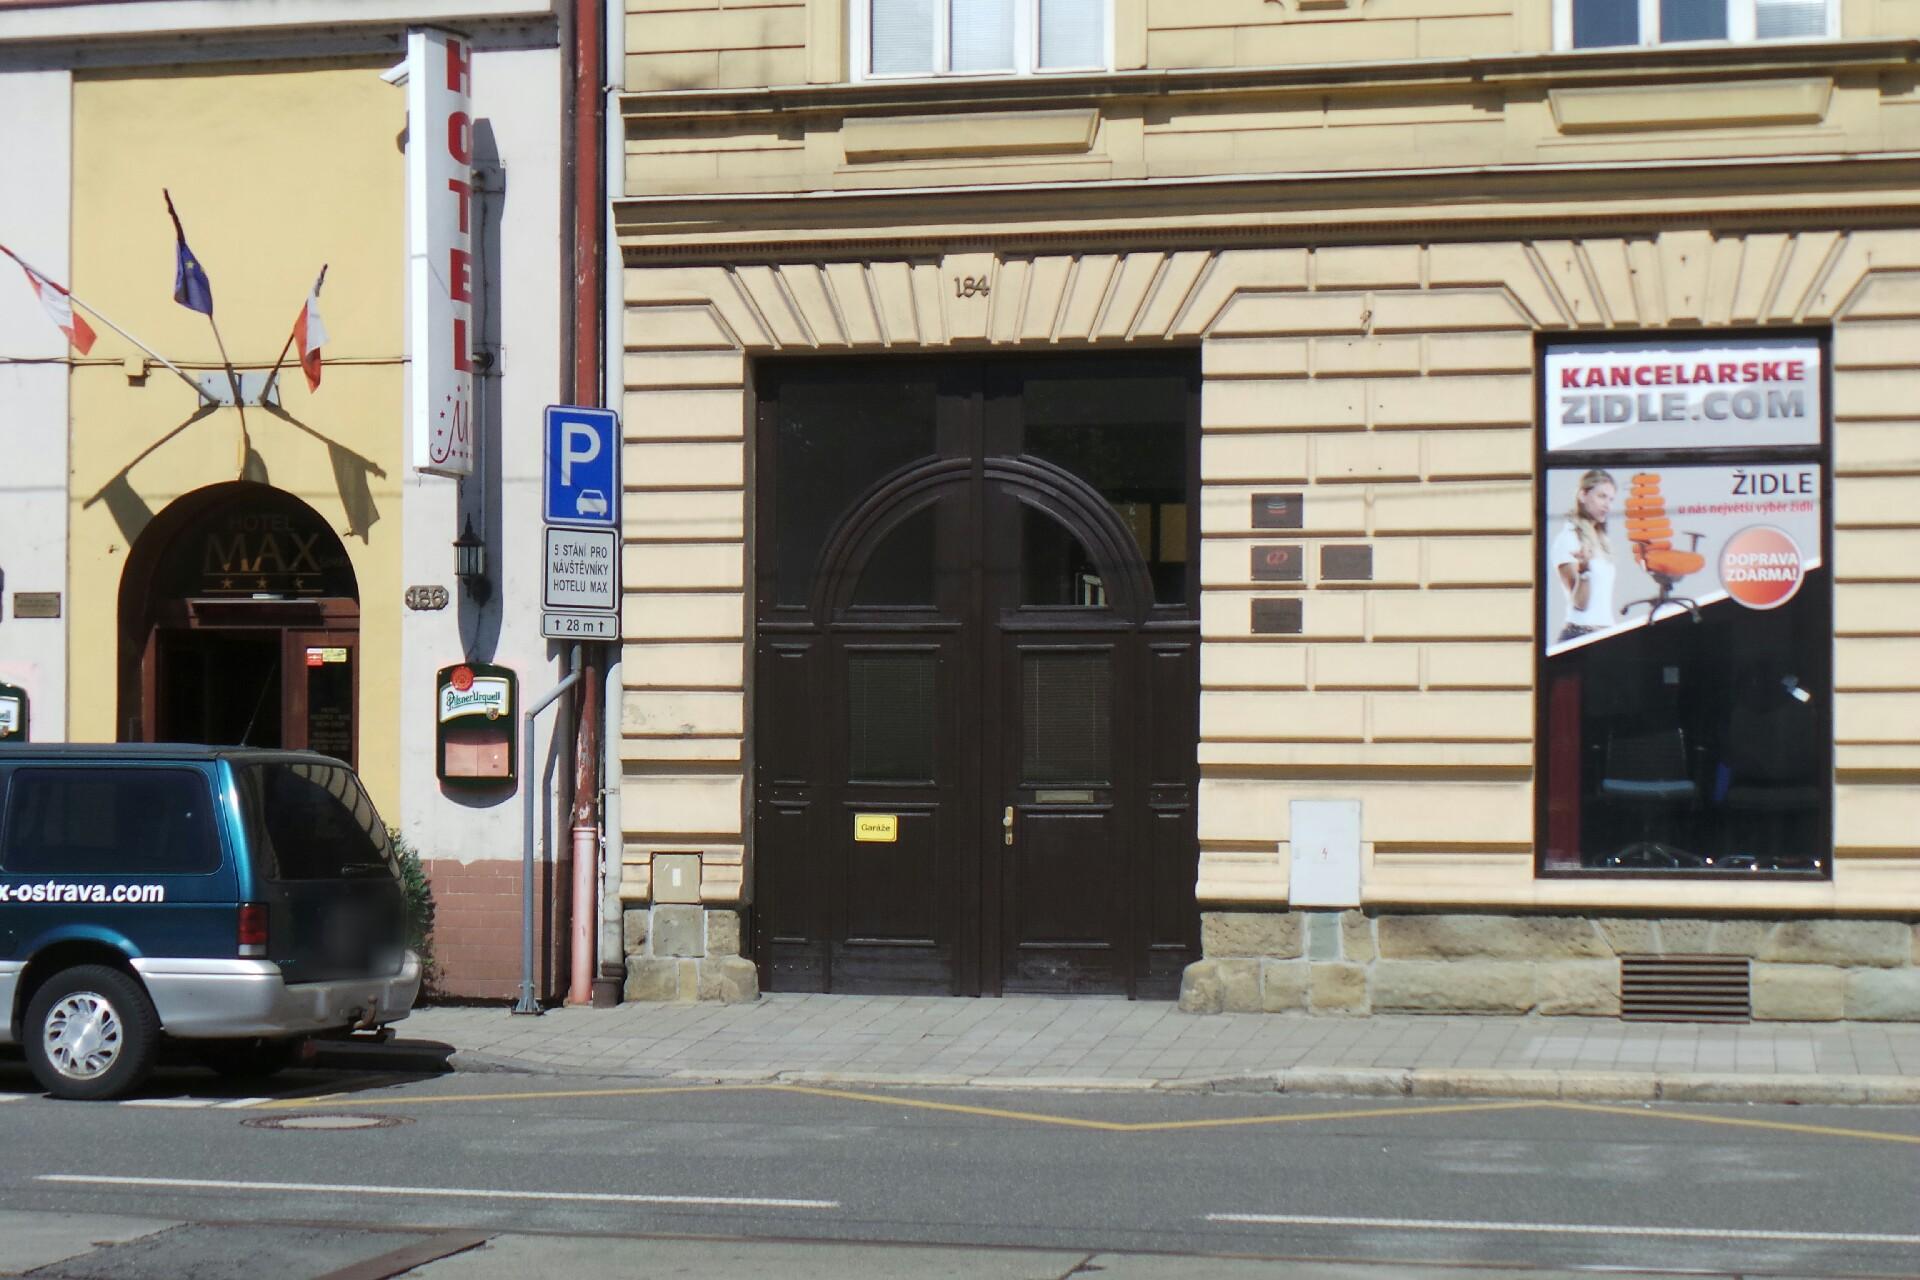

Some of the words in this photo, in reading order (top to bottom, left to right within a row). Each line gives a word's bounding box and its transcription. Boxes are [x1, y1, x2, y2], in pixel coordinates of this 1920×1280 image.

[447, 38, 473, 374] HOTEL
[954, 275, 991, 298] 184
[1561, 361, 1805, 388] KANCELARSKE
[1561, 389, 1805, 425] ZIDLE.COM
[561, 422, 601, 486] P
[1732, 469, 1812, 495] ŽIDLE
[228, 514, 294, 531] HOTEL
[204, 532, 323, 572] MAX
[554, 544, 559, 556] 5
[562, 542, 587, 557] STÁNÍ
[590, 546, 607, 558] PRO
[1726, 552, 1798, 565] DOPRAVA
[553, 559, 608, 575] NÁVŠTĚVNÍKY
[1726, 567, 1798, 581] ZDARMA!
[553, 579, 586, 592] HOTELU
[590, 580, 608, 593] MAX
[566, 619, 580, 631] 28
[583, 622, 594, 632] m
[446, 690, 473, 711] Pilsner
[472, 690, 501, 705] Urquell
[0, 880, 164, 902] x-ostrava.com
